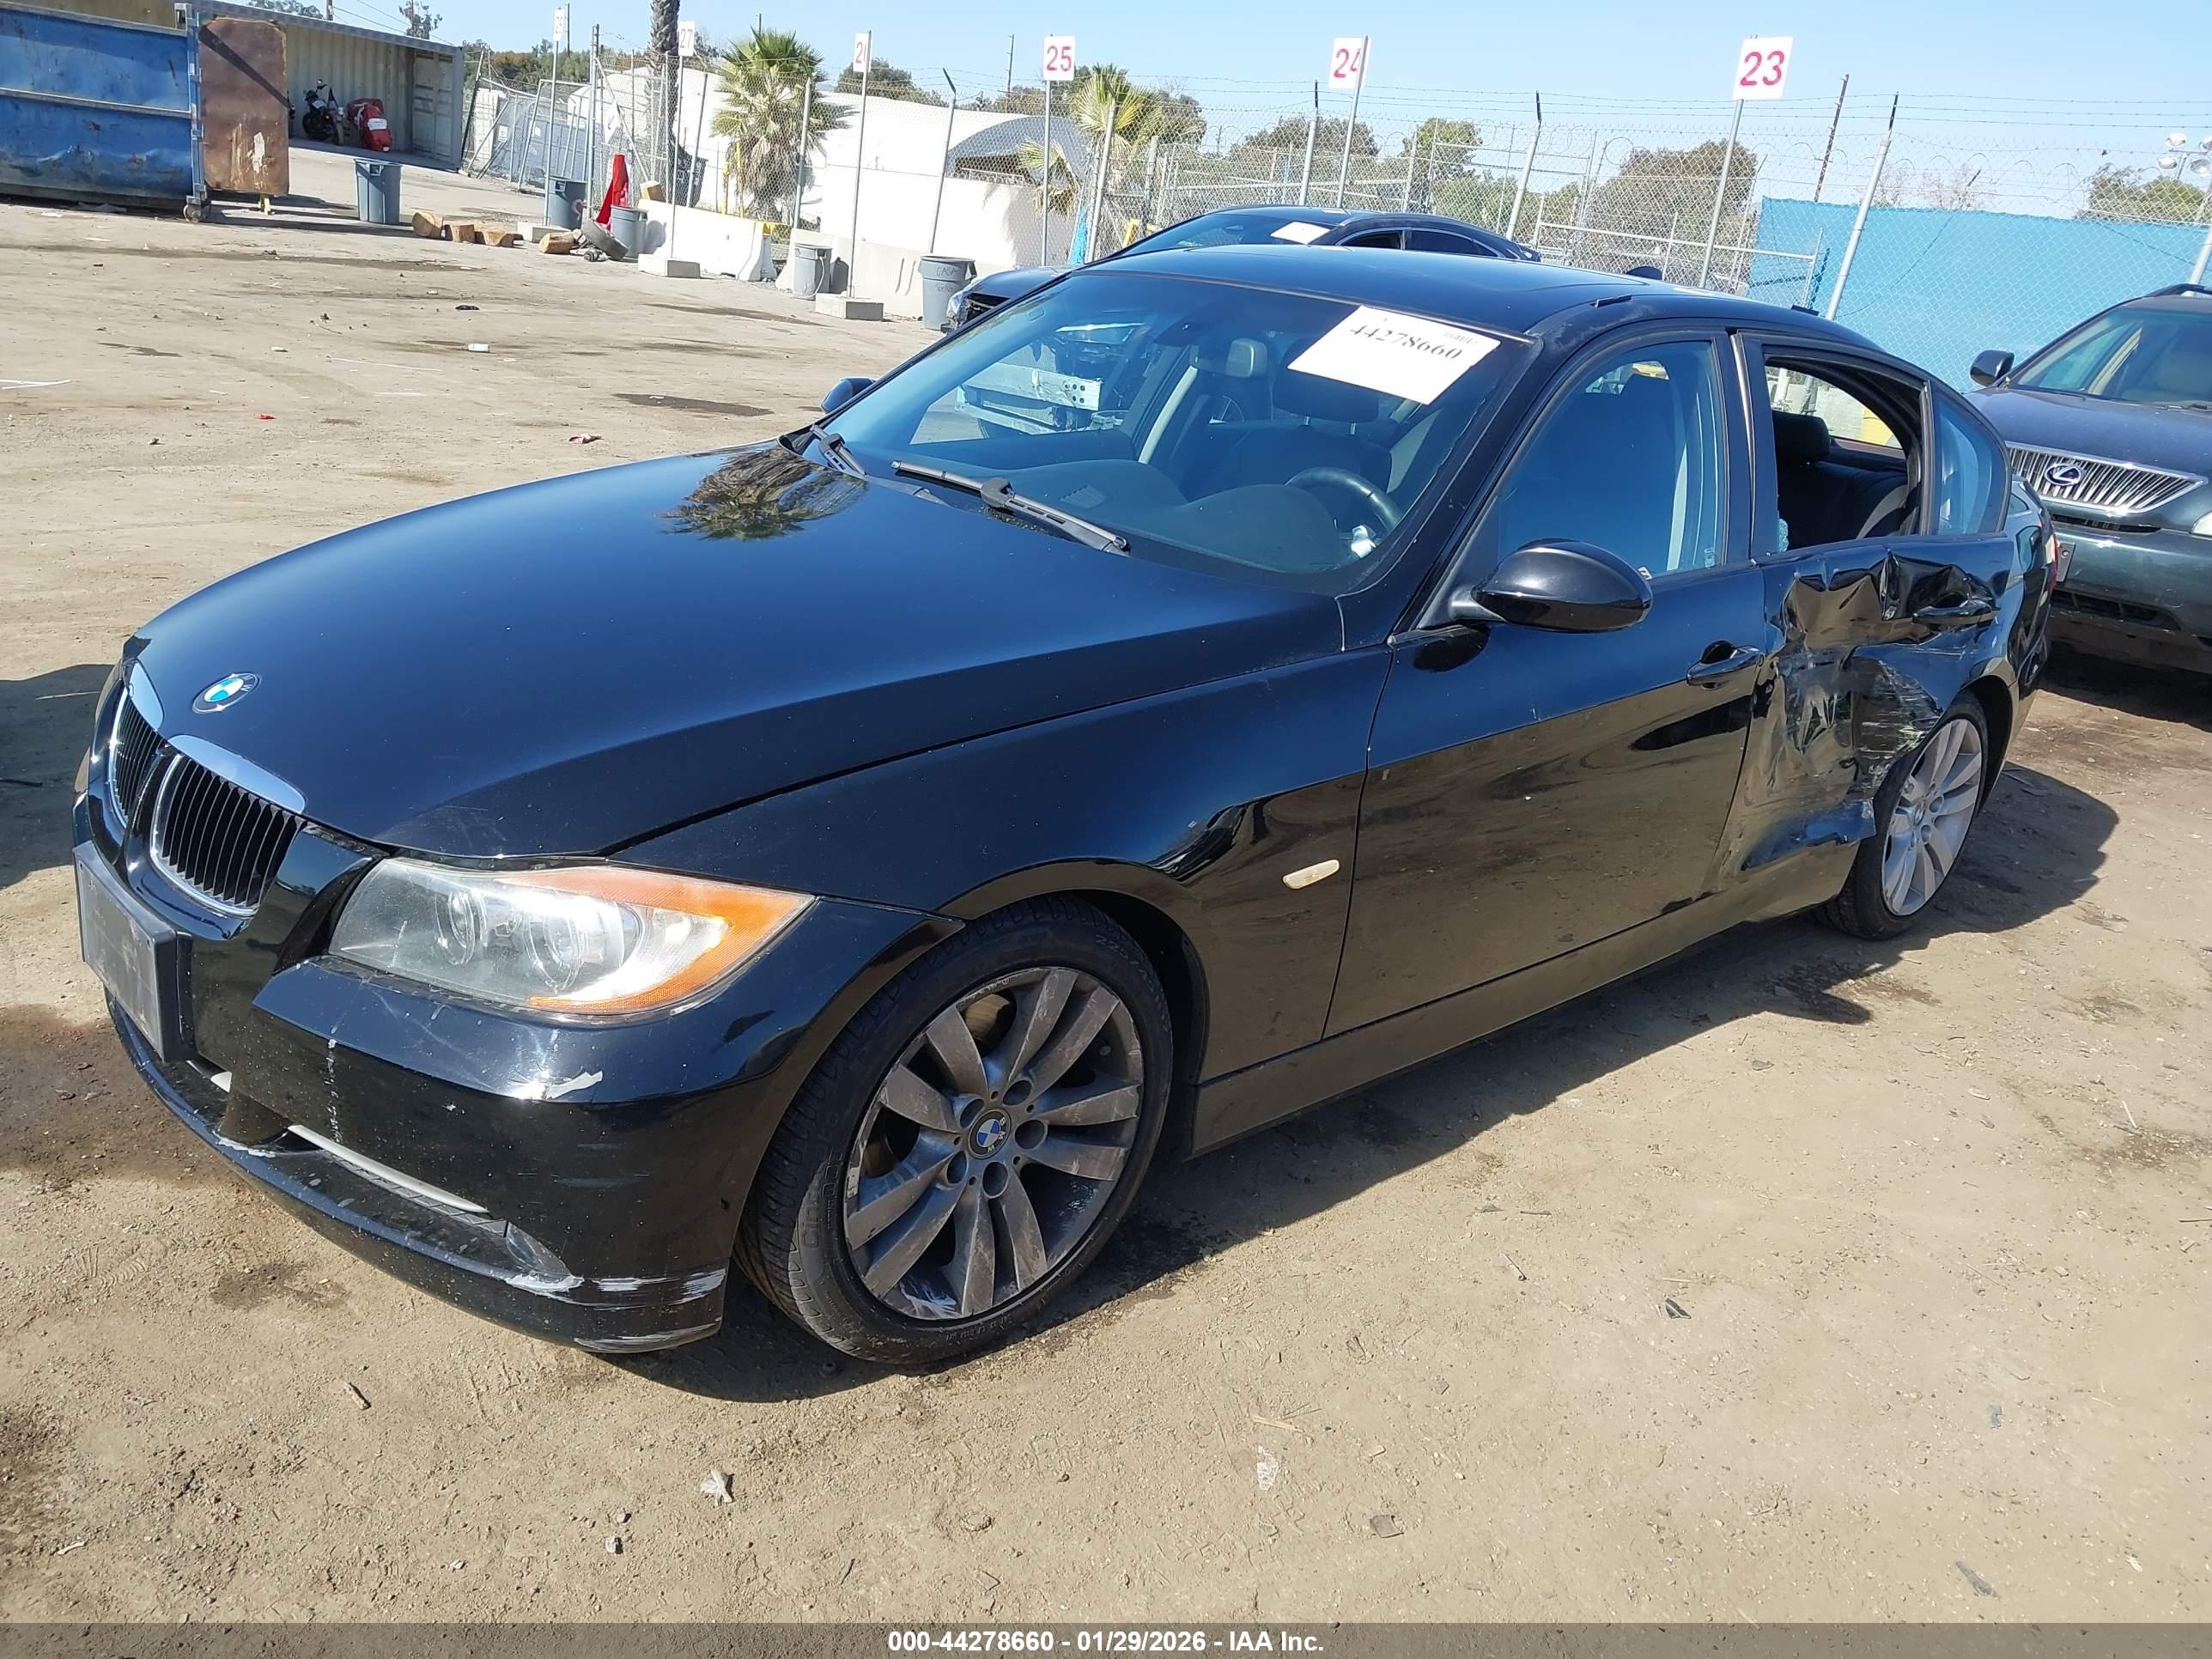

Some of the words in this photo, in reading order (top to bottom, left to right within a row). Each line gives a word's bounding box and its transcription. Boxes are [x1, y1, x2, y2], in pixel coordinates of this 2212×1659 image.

[679, 28, 693, 49] 27
[1047, 45, 1073, 72] 25
[1740, 50, 1785, 86] 23
[1350, 325, 1462, 361] 44278660
[987, 1116, 1007, 1153] BMW
